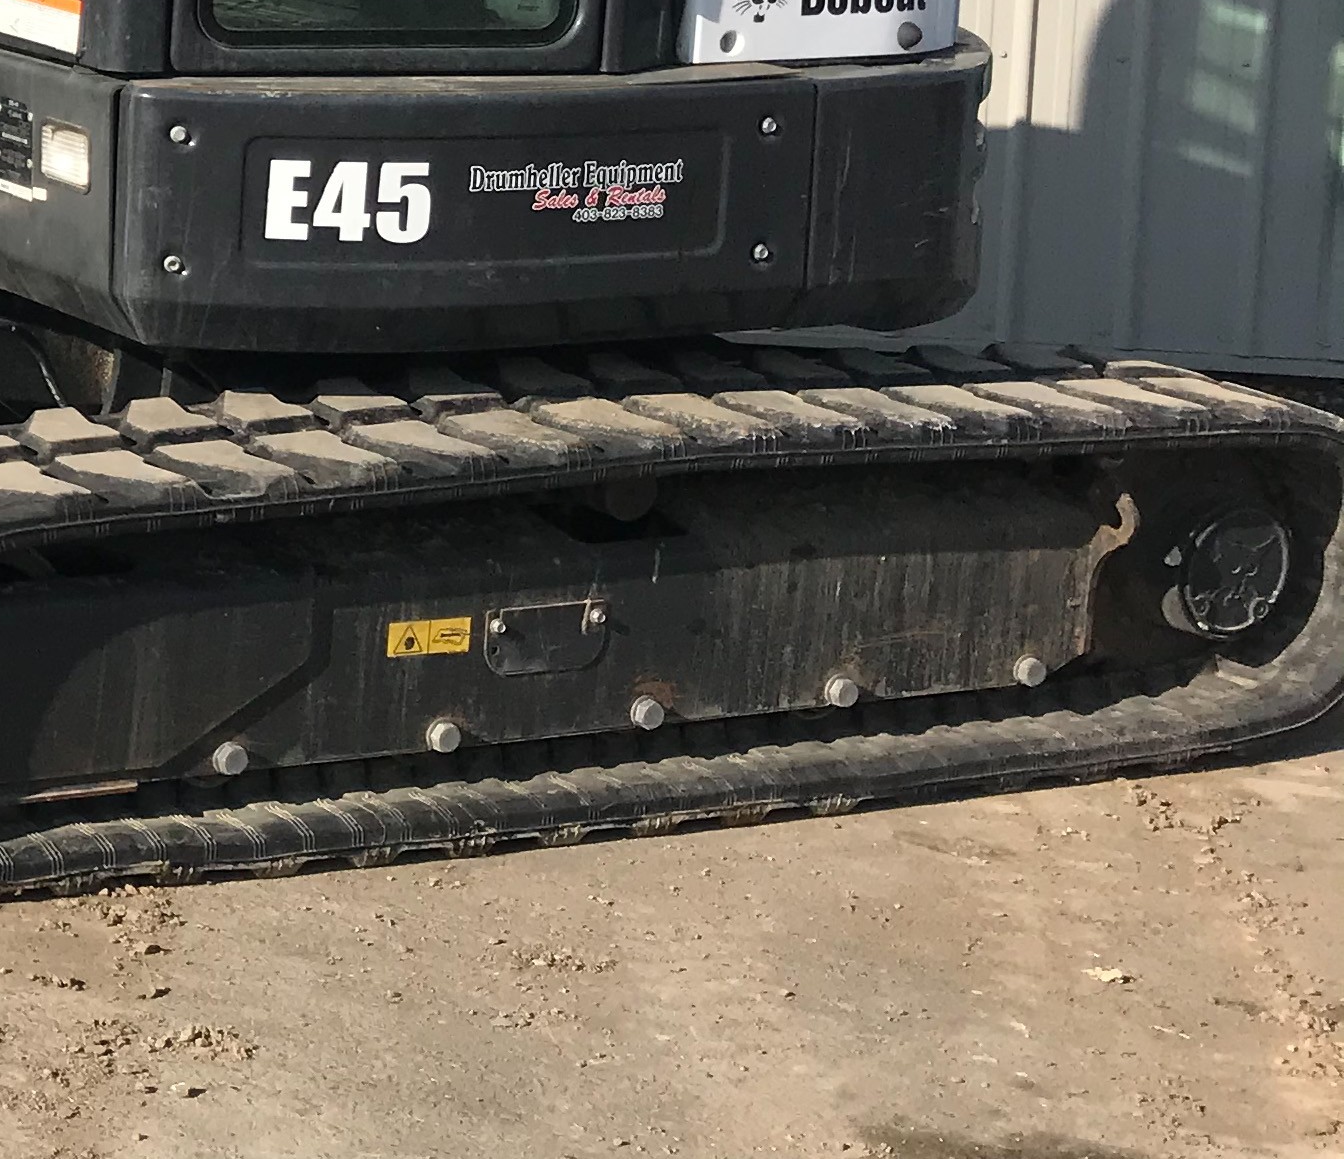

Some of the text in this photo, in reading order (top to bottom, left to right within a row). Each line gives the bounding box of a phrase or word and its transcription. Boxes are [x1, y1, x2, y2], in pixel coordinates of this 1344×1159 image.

[469, 159, 684, 192] Drumheller Equipment
[264, 159, 431, 244] E45
[532, 185, 667, 211] Sales & Rentals
[572, 204, 663, 222] 403-823-8383
